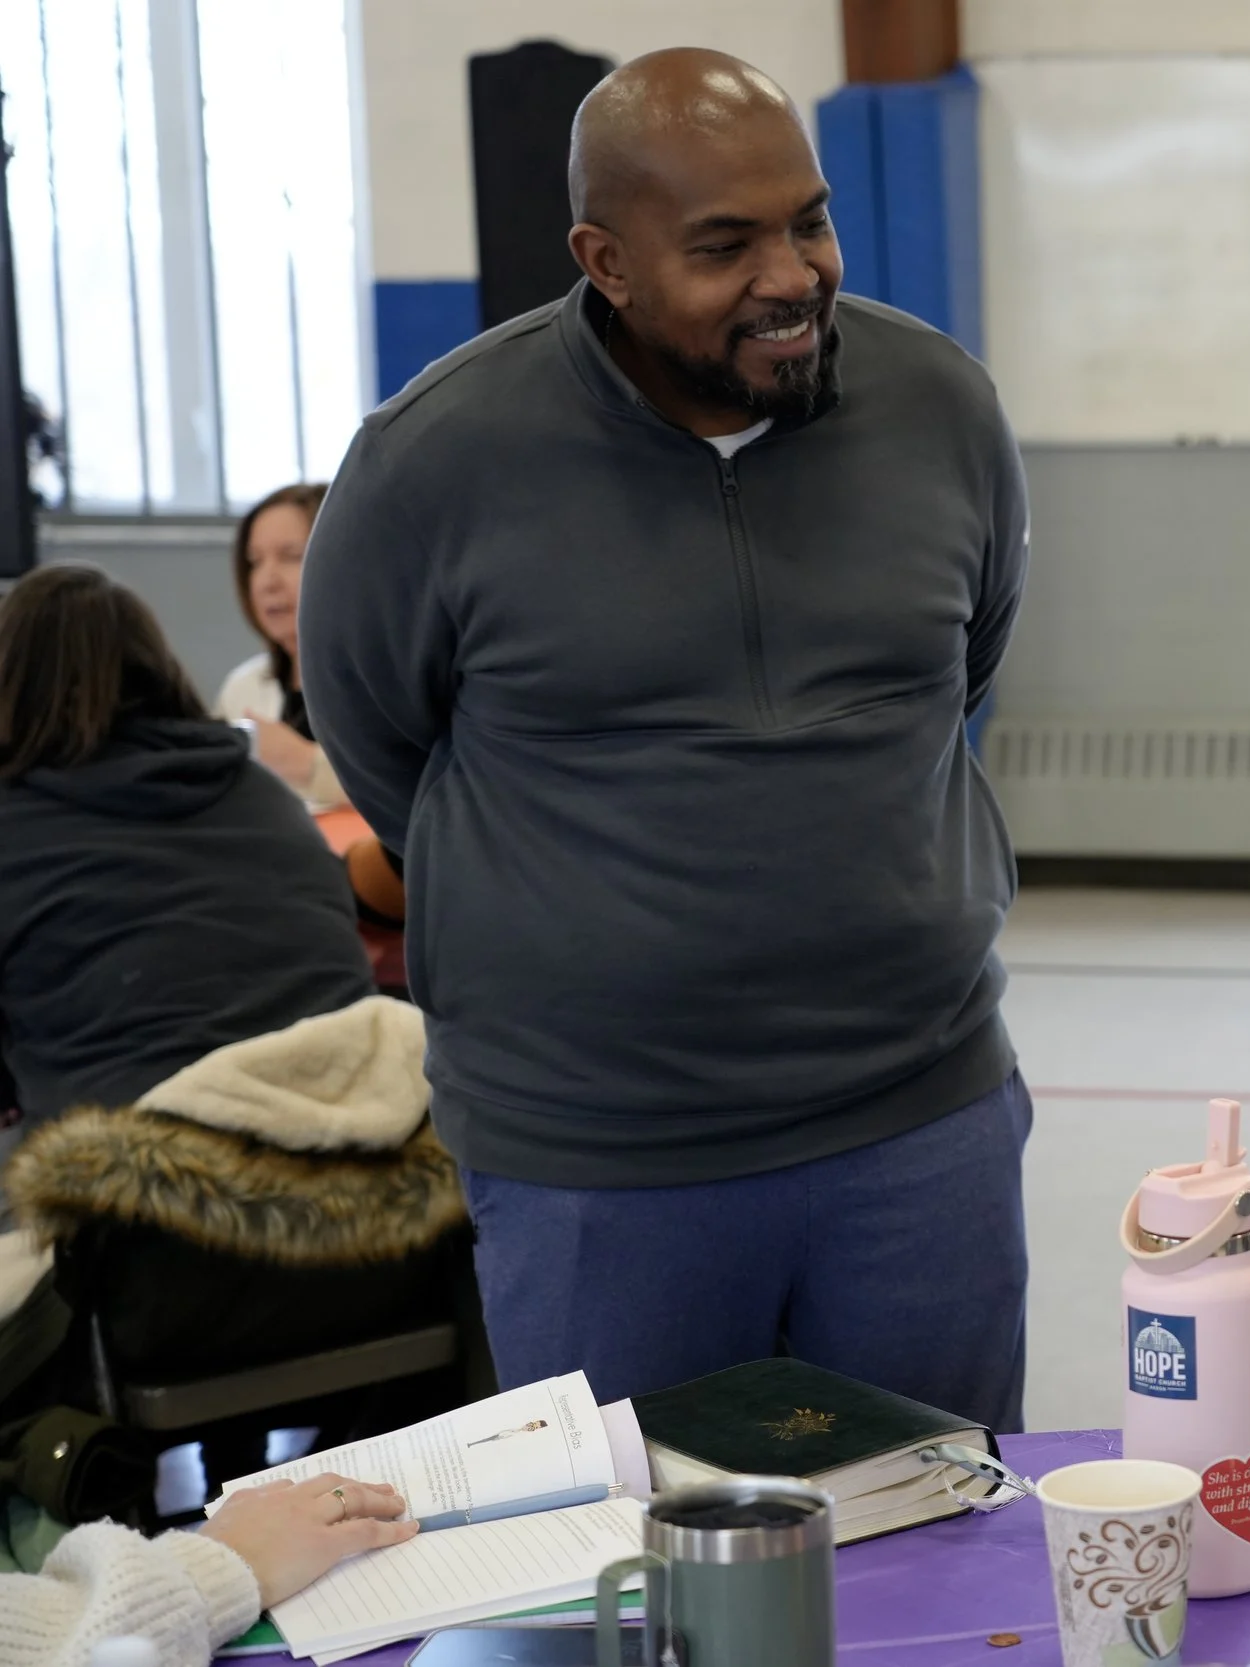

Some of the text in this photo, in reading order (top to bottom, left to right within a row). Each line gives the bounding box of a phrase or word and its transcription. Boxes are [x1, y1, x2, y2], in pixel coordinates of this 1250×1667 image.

[1134, 1347, 1186, 1380] HOPE
[1135, 1374, 1186, 1386] BAPTIST CHURCH
[558, 1393, 582, 1450] Representative Bias
[1208, 1472, 1229, 1485] She
[1232, 1470, 1242, 1482] is
[1206, 1486, 1233, 1500] with
[1212, 1500, 1234, 1514] and
